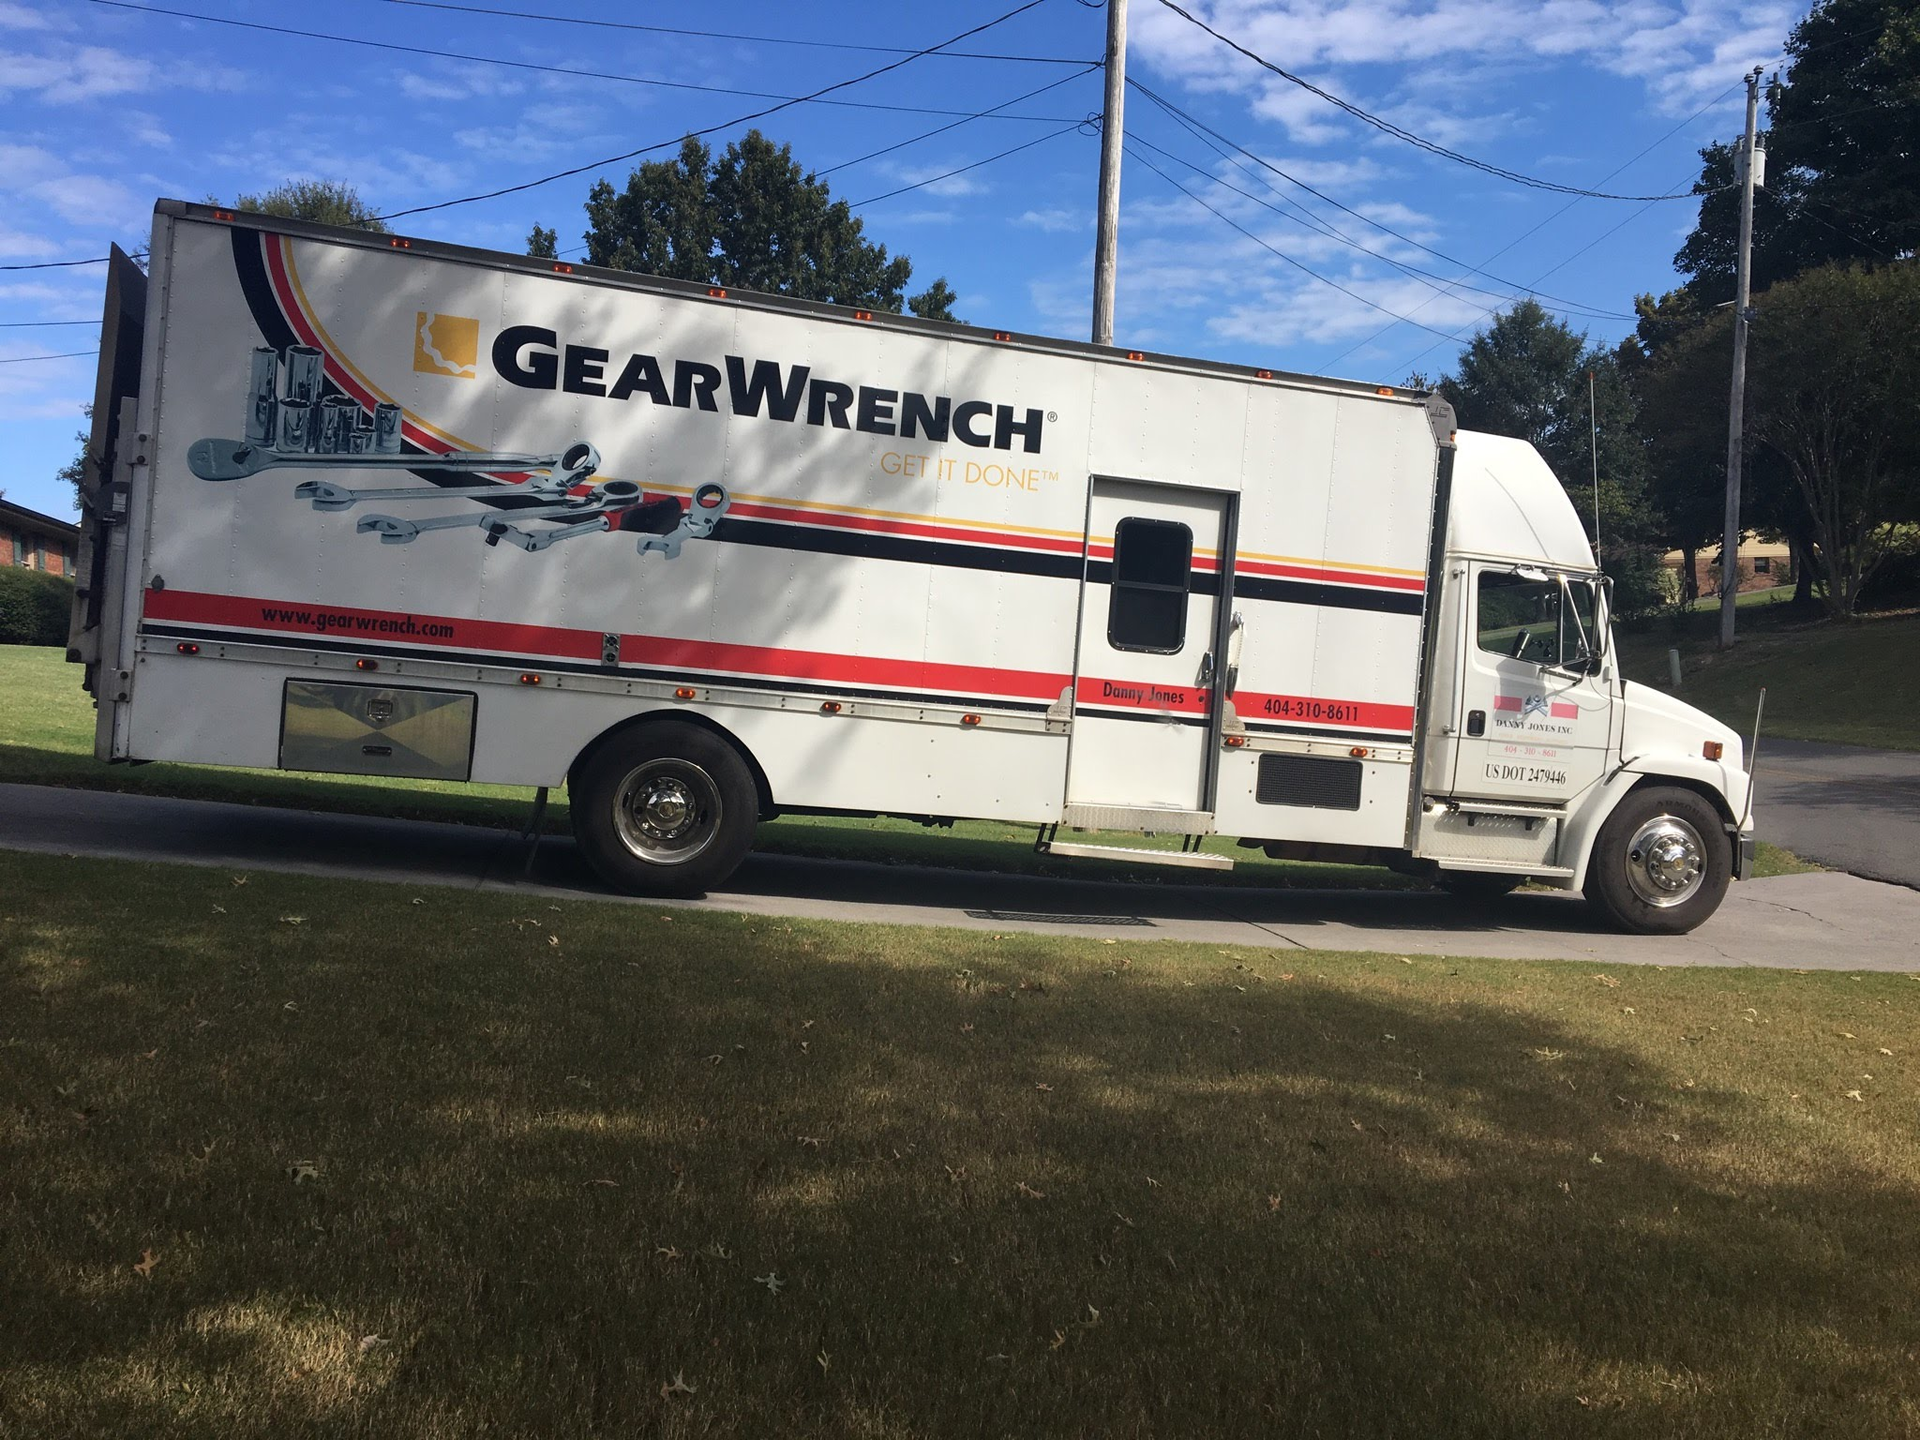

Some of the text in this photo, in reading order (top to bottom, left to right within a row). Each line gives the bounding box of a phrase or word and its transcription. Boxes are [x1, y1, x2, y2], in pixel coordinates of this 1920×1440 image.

[880, 451, 930, 478] GET
[938, 458, 957, 481] IT
[262, 608, 454, 639] www.gearwrench.com
[1103, 681, 1185, 705] Danny Jones
[1264, 698, 1358, 721] 404-310-8611
[1495, 719, 1573, 735] DANNY JONES INC
[1504, 745, 1517, 754] 404
[1524, 747, 1536, 756] 310
[1485, 763, 1567, 786] US DOT 2479446
